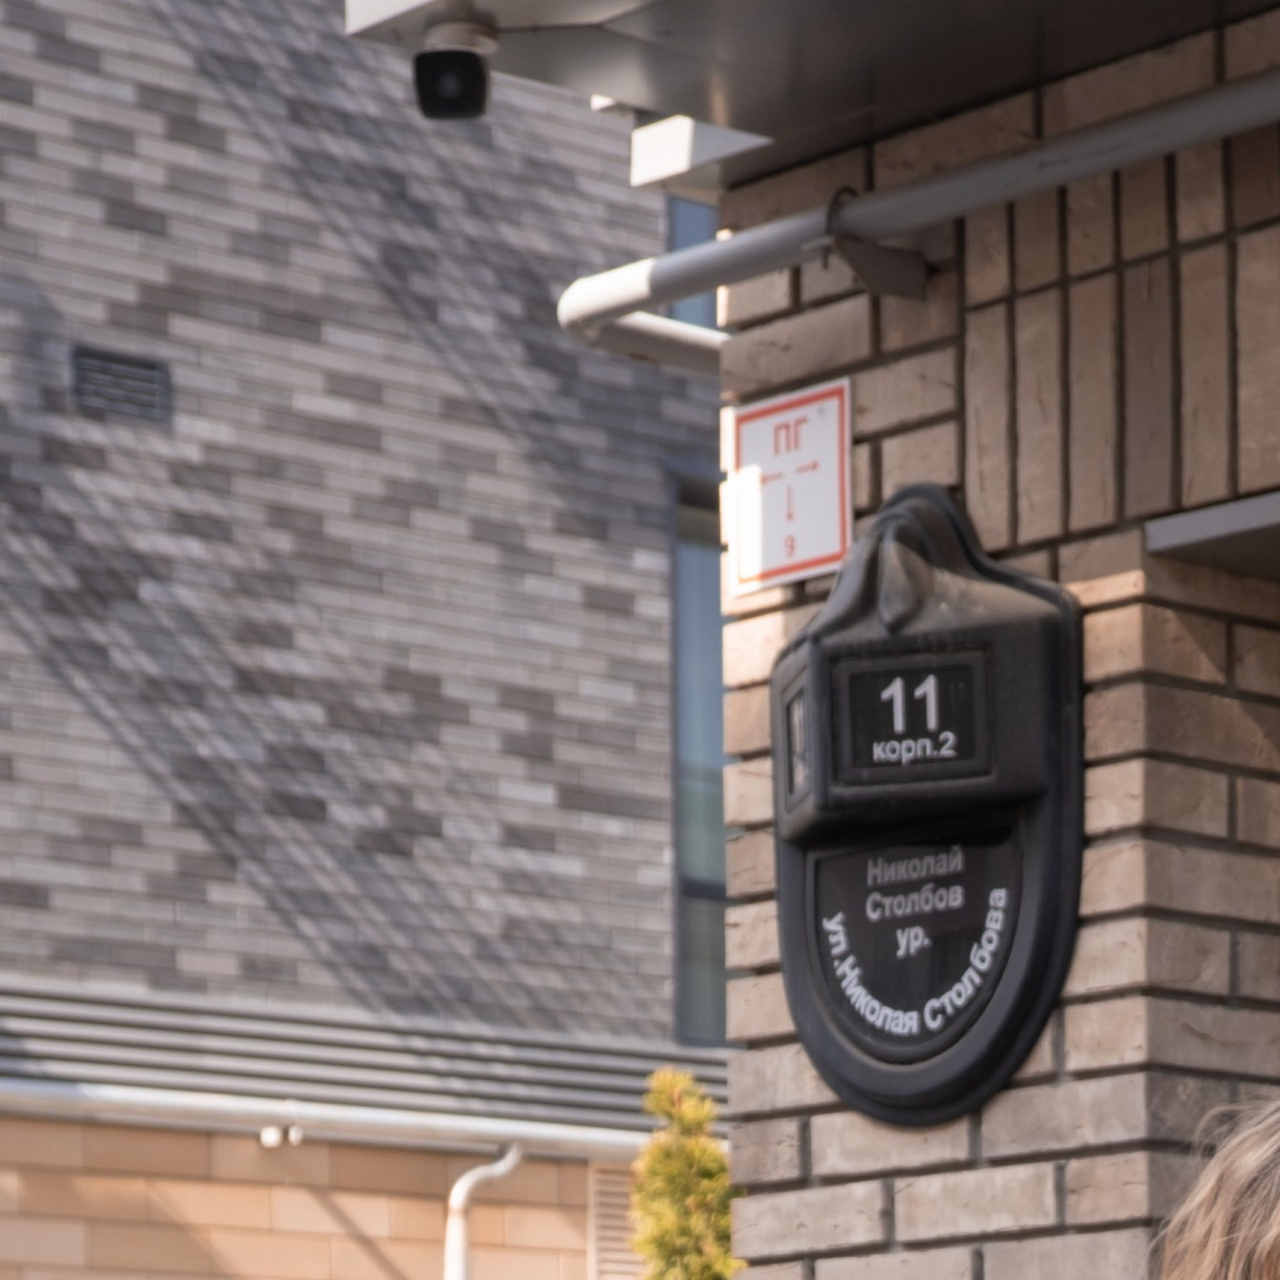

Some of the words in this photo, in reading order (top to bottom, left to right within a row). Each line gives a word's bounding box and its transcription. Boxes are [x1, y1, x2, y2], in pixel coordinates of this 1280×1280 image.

[774, 418, 809, 455] ПГ
[784, 534, 797, 557] 9
[881, 674, 939, 734] 11
[866, 846, 963, 886] Николай
[866, 884, 963, 920] Столбов
[896, 926, 931, 958] ур.
[923, 888, 1007, 1030] Столбова
